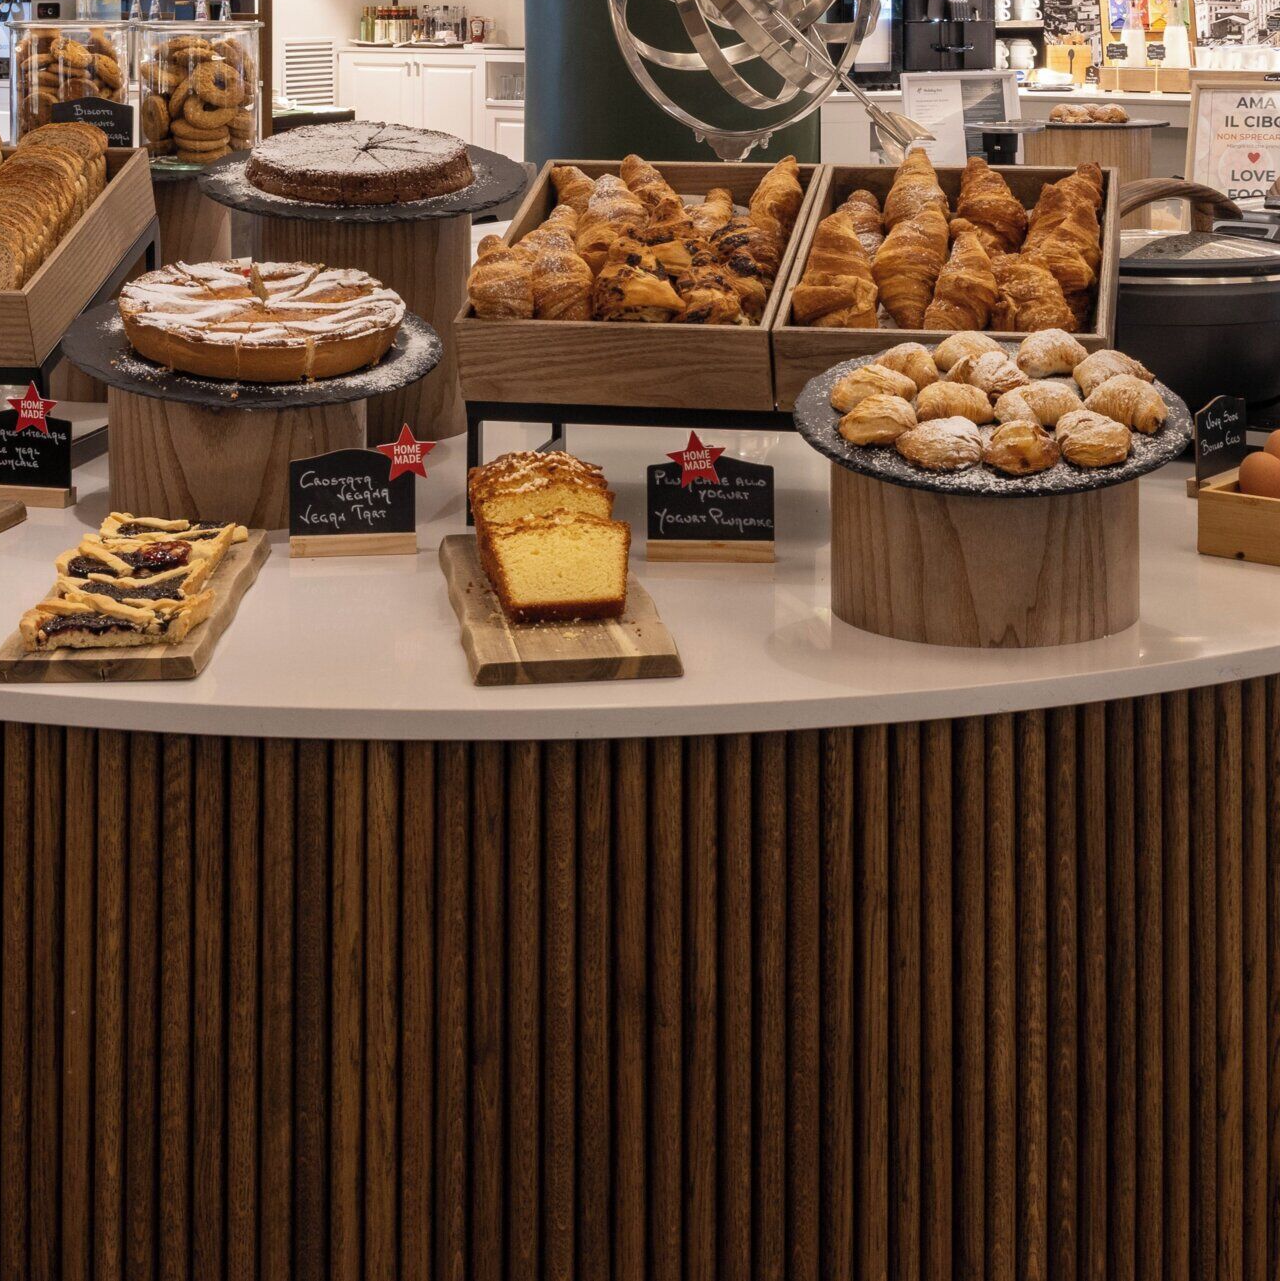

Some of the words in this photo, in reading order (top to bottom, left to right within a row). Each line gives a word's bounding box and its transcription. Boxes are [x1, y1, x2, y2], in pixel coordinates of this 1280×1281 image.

[1236, 96, 1277, 109] AMA
[1225, 115, 1239, 128] IL
[1216, 133, 1237, 141] NON
[1240, 133, 1280, 141] SPRECAR
[1231, 169, 1276, 182] LOVE
[1228, 188, 1270, 200] FOO
[20, 400, 44, 411] HOME
[20, 410, 45, 420] MADE
[393, 443, 421, 454] HOME
[393, 453, 422, 465] MADE
[682, 449, 711, 461] HOME
[684, 460, 713, 471] MADE
